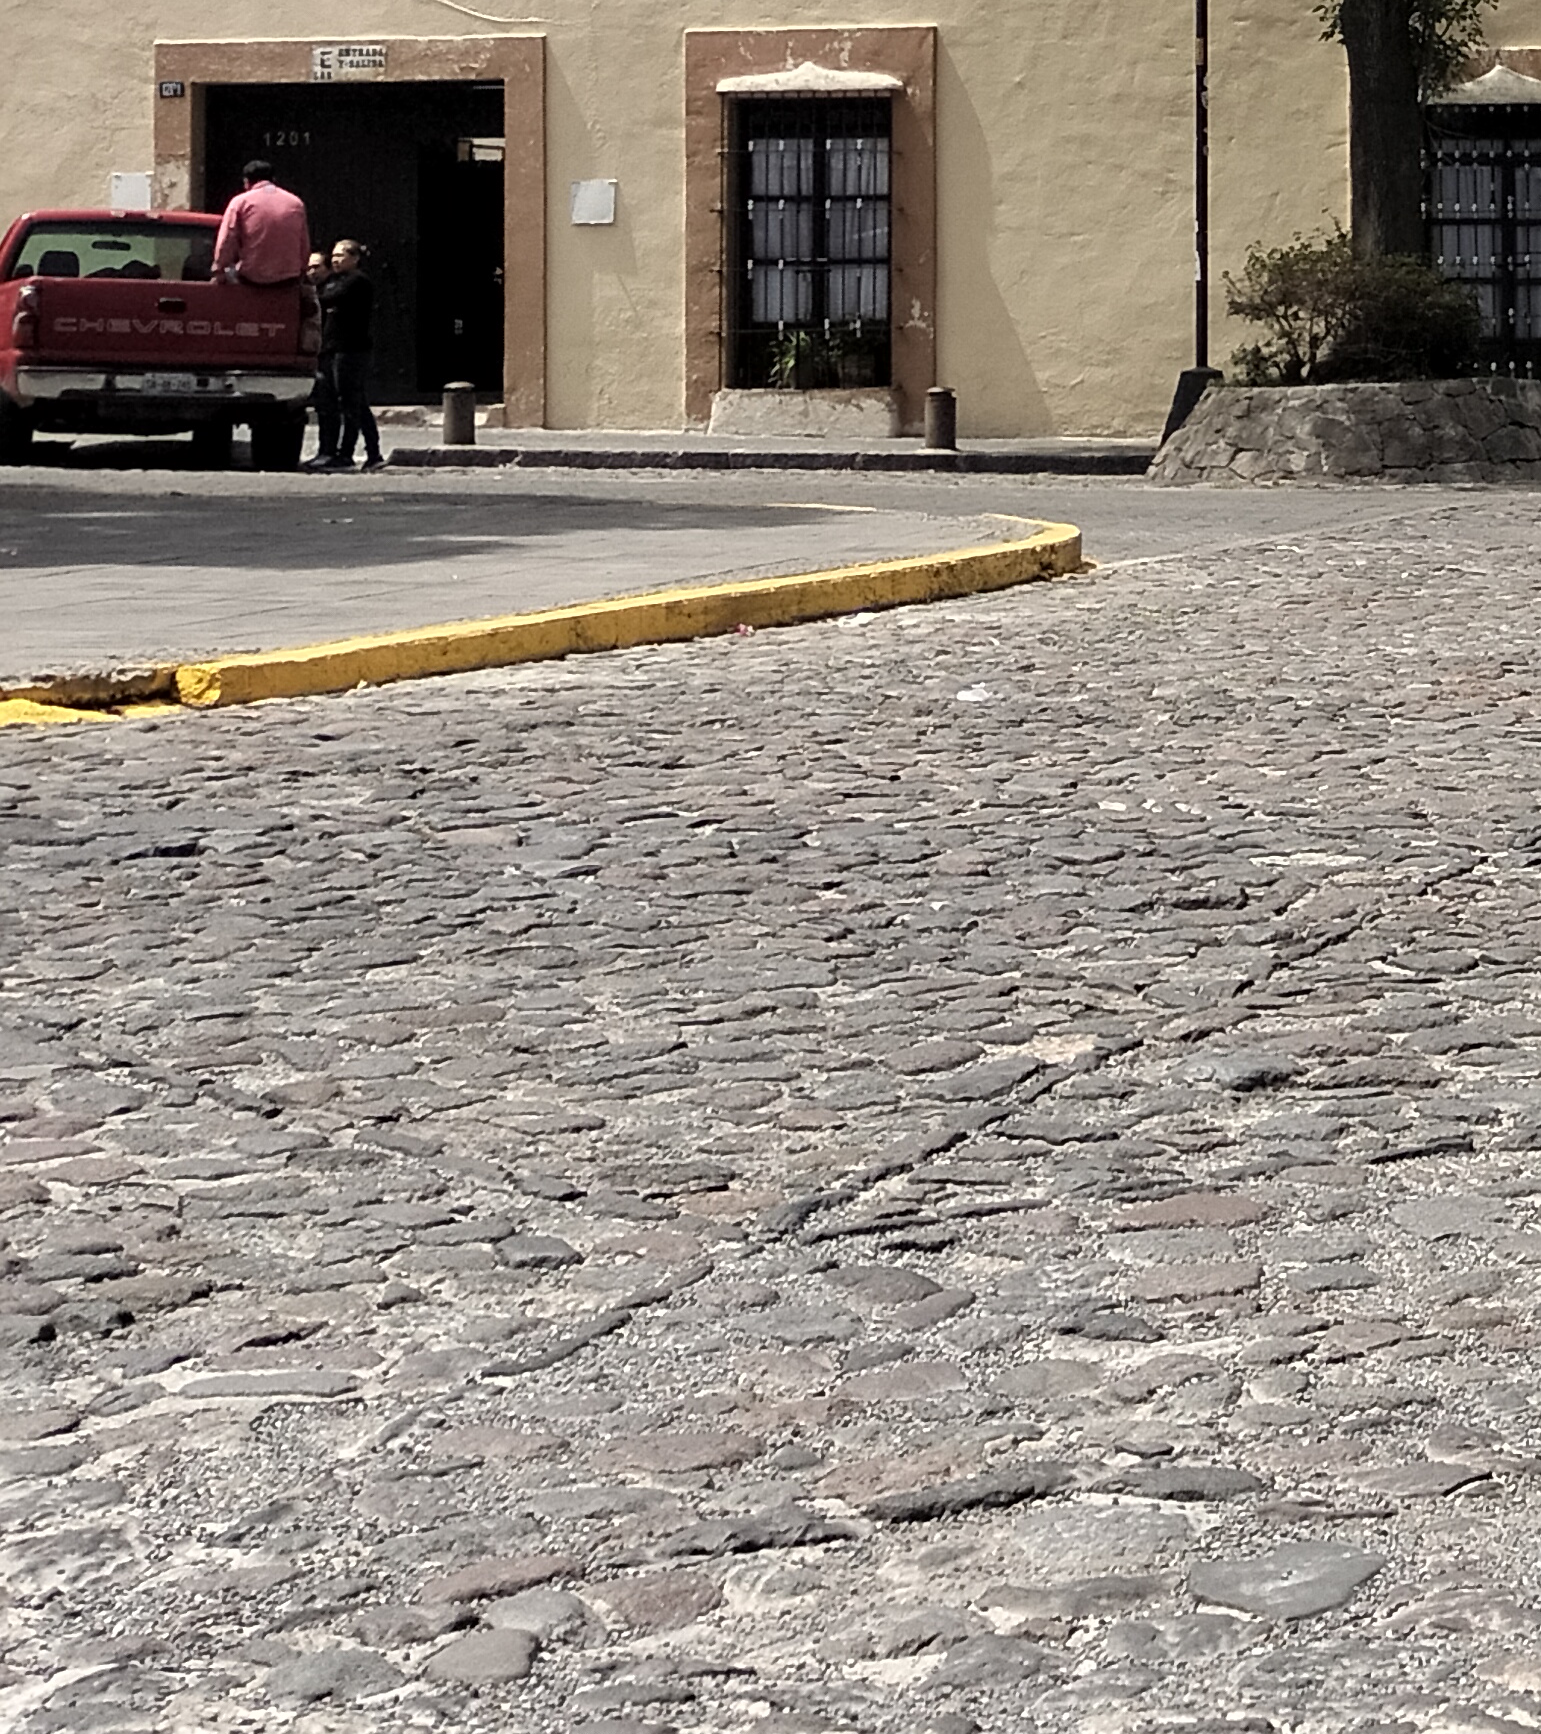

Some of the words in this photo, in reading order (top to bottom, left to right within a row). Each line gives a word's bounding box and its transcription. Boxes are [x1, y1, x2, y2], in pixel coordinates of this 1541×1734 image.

[338, 48, 384, 57] ENTRADA
[349, 59, 384, 68] SALIDA
[263, 130, 311, 147] 1201
[53, 318, 286, 337] CHEVROLET
